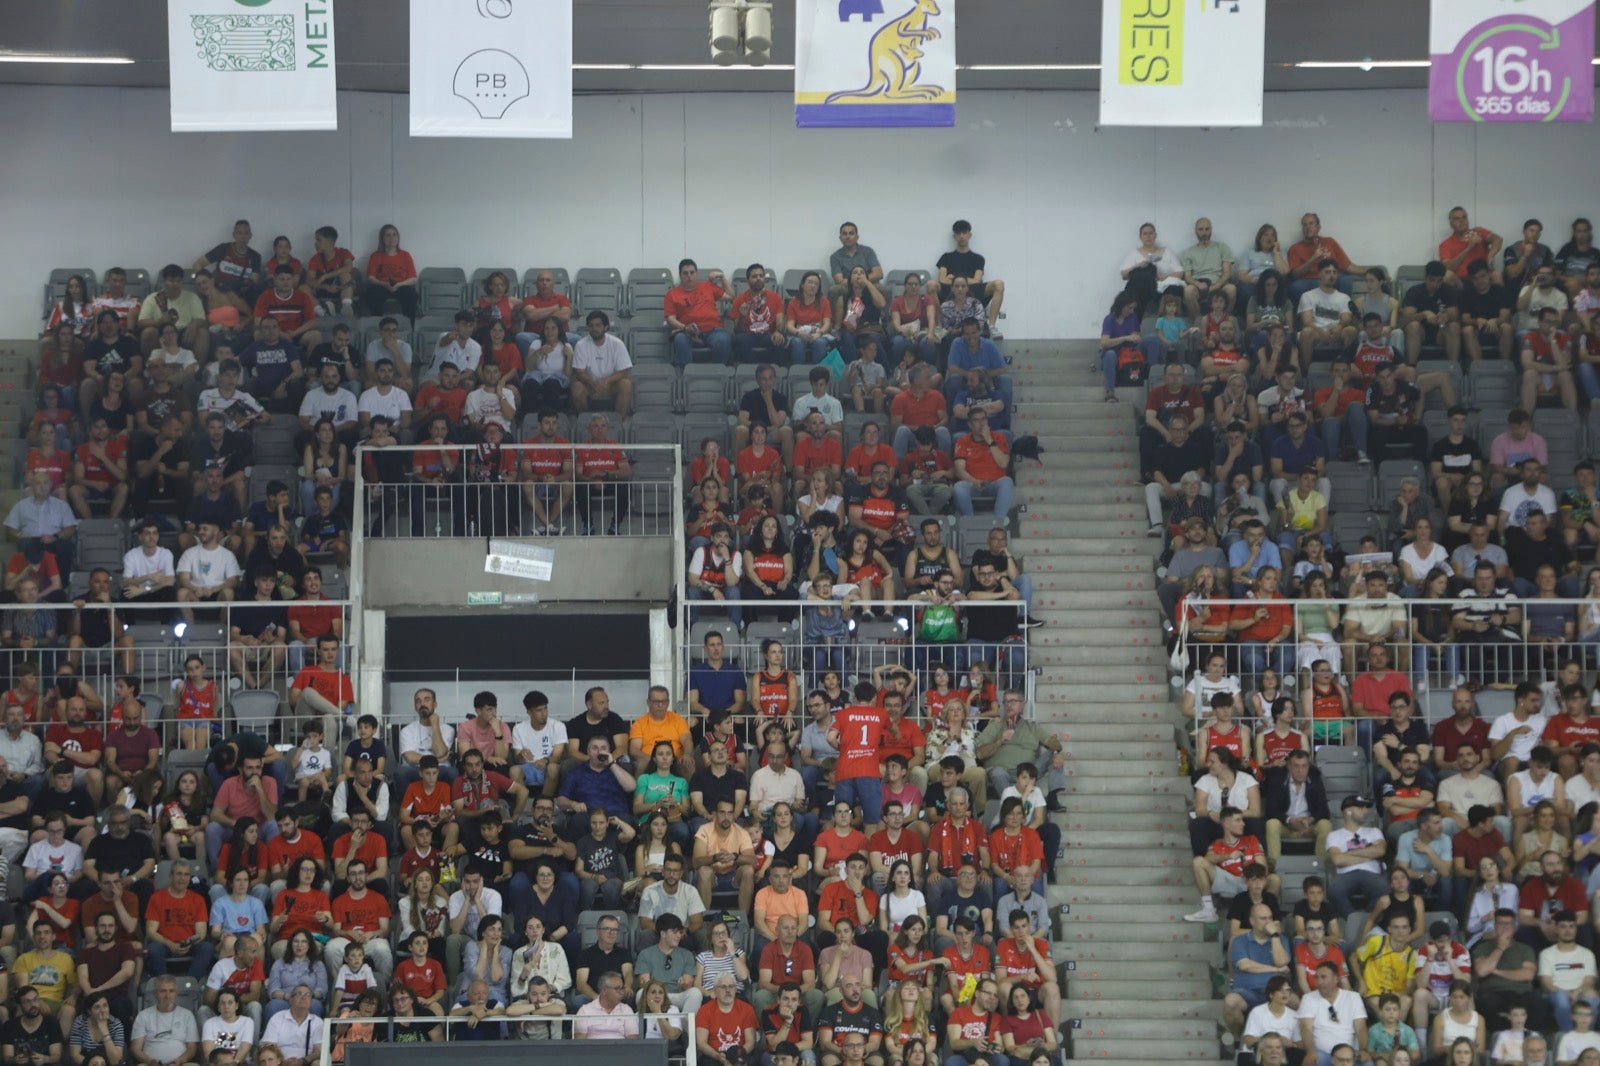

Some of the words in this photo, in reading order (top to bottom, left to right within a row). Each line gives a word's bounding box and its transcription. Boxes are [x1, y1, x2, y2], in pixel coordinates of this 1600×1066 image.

[305, 0, 328, 68] MET
[1473, 45, 1551, 94] 16h
[476, 73, 507, 89] PB
[1475, 96, 1512, 114] 365
[849, 714, 880, 723] PULEVA
[860, 724, 868, 746] 1
